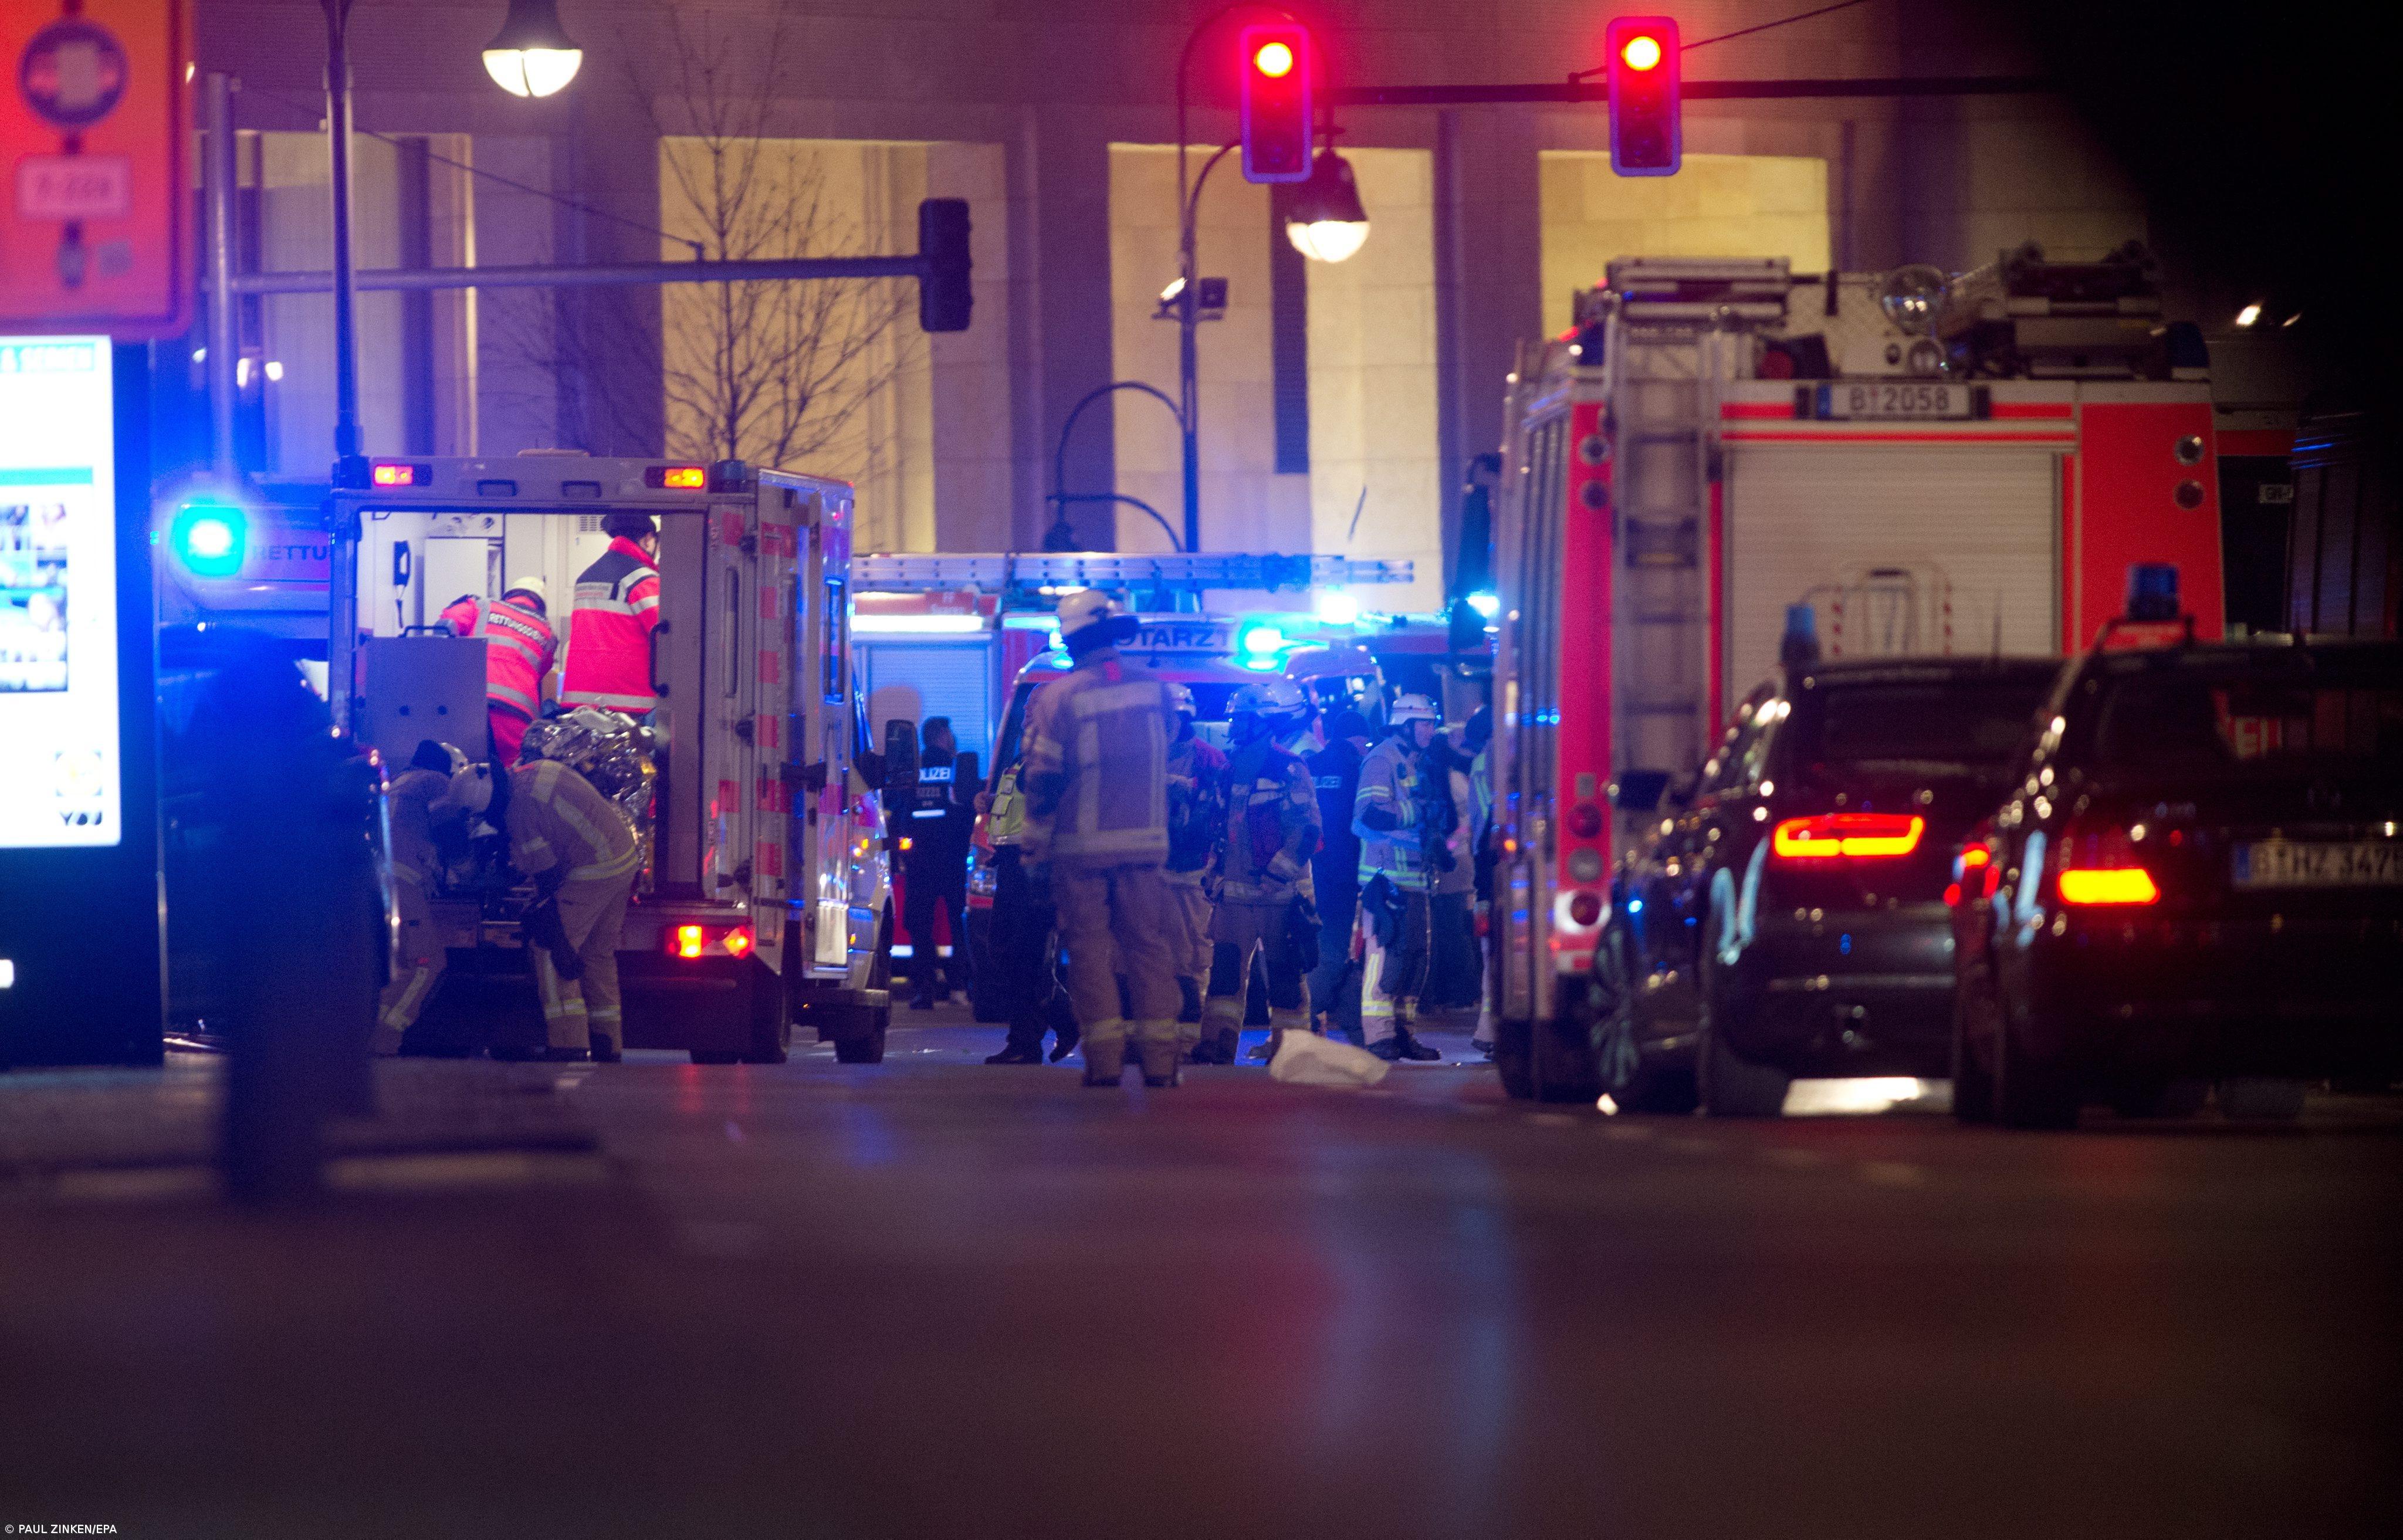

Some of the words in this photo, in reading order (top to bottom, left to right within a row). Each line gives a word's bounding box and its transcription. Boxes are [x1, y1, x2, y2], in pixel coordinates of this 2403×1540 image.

[1850, 386, 1866, 410] B
[1883, 386, 1950, 411] 2058
[59, 810, 102, 826] YOU
